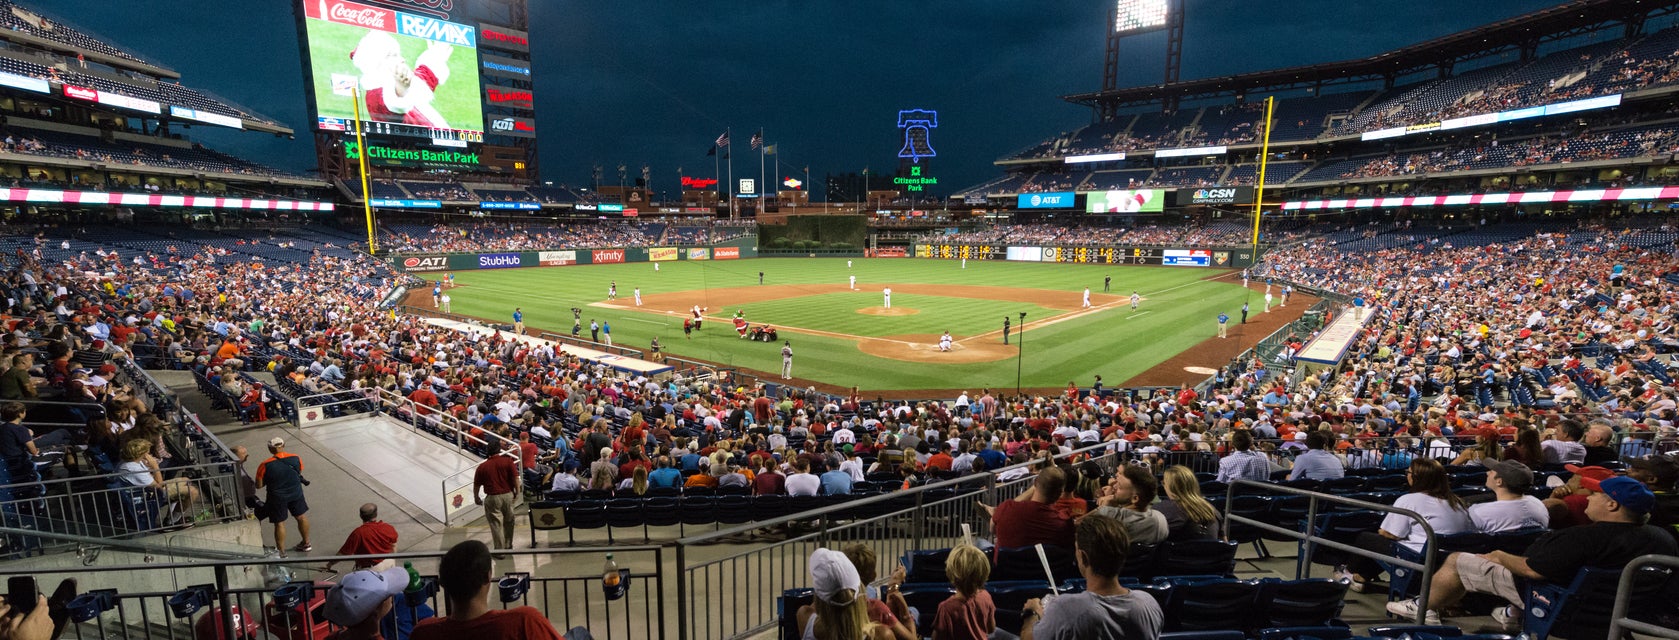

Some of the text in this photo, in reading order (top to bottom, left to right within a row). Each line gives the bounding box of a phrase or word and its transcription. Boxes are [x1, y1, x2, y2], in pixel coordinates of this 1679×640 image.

[331, 3, 387, 28] Coca-Cola
[401, 15, 471, 46] RE/MAX
[367, 145, 480, 164] Citizens Bank Park
[907, 184, 923, 192] Park
[1209, 188, 1236, 198] CSN
[1042, 196, 1061, 204] AT&T
[418, 257, 448, 267] ATI
[479, 254, 520, 266] StubHub
[594, 249, 623, 263] xfinity
